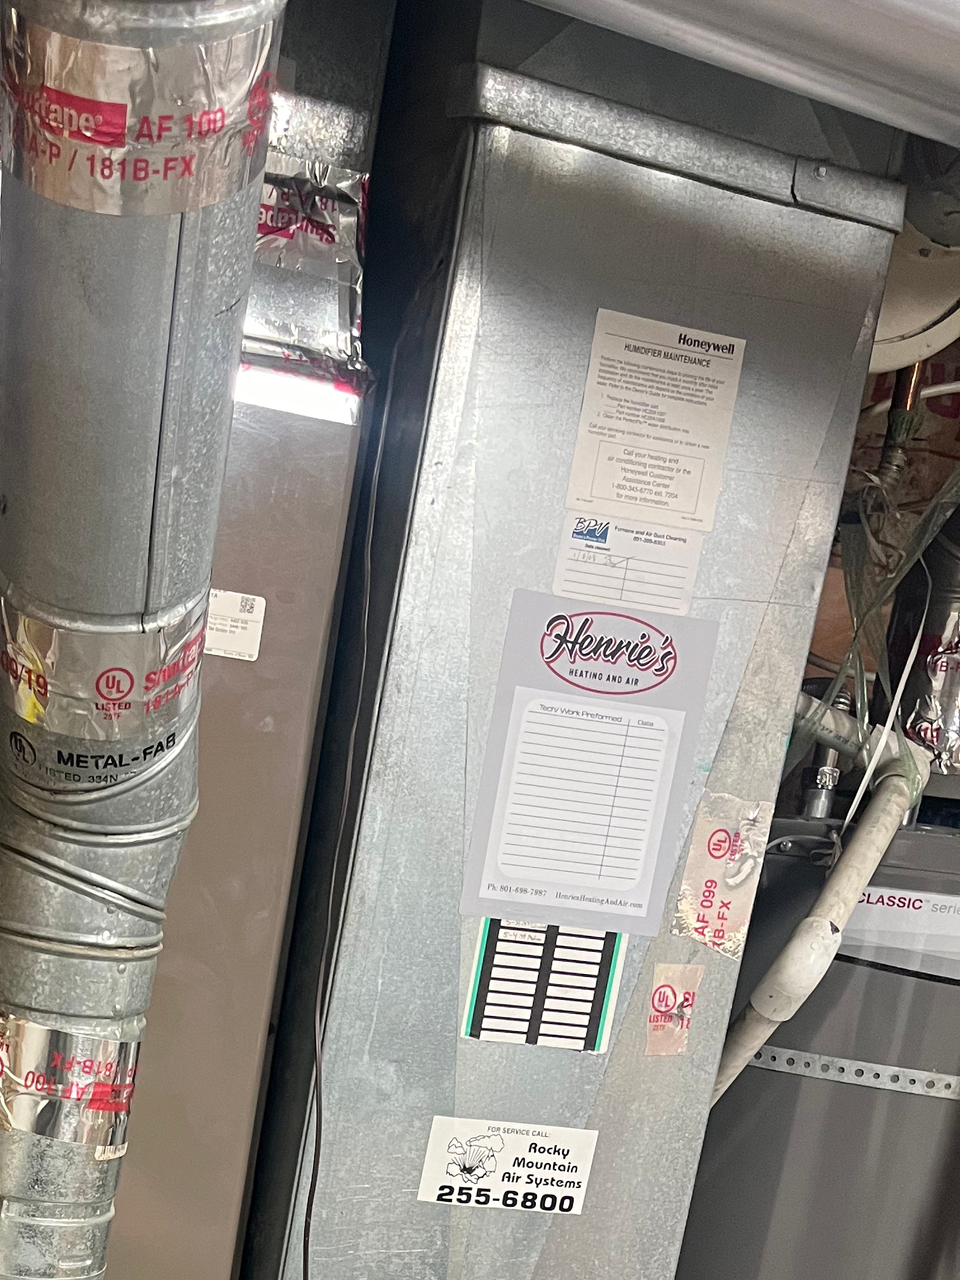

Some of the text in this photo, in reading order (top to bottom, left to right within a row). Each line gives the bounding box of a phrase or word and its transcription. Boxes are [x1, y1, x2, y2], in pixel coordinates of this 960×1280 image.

[134, 115, 174, 143] AF
[183, 108, 226, 138] 100
[86, 153, 196, 182] 181B-FX
[678, 333, 735, 355] Honeywell
[624, 343, 711, 368] HUMIDIFIER MAINTENANCE
[615, 457, 647, 469] conditioning
[648, 462, 674, 473] contractor
[635, 451, 646, 459] your
[648, 454, 667, 464] heating
[621, 466, 674, 481] Honeywell Customer
[622, 476, 651, 486] Assistance
[665, 491, 678, 499] 7204
[574, 517, 610, 536] BPV
[666, 534, 687, 543] Cleaning
[545, 613, 673, 676] Henrie's
[568, 668, 640, 687] HEATING AND AIR
[95, 701, 132, 712] LISTED
[560, 708, 580, 716] Work
[56, 733, 177, 769] METAL-FAB
[555, 892, 643, 908] HenriesHeatingAndAir.com
[695, 879, 719, 936] AF 099
[649, 1014, 673, 1023] LISTED
[24, 1070, 55, 1092] 100
[502, 1127, 530, 1136] SERVICE
[528, 1142, 570, 1159] Rocky
[512, 1157, 578, 1173] Mountain
[501, 1172, 582, 1189] Air Systems
[436, 1185, 575, 1212] 255-6800
